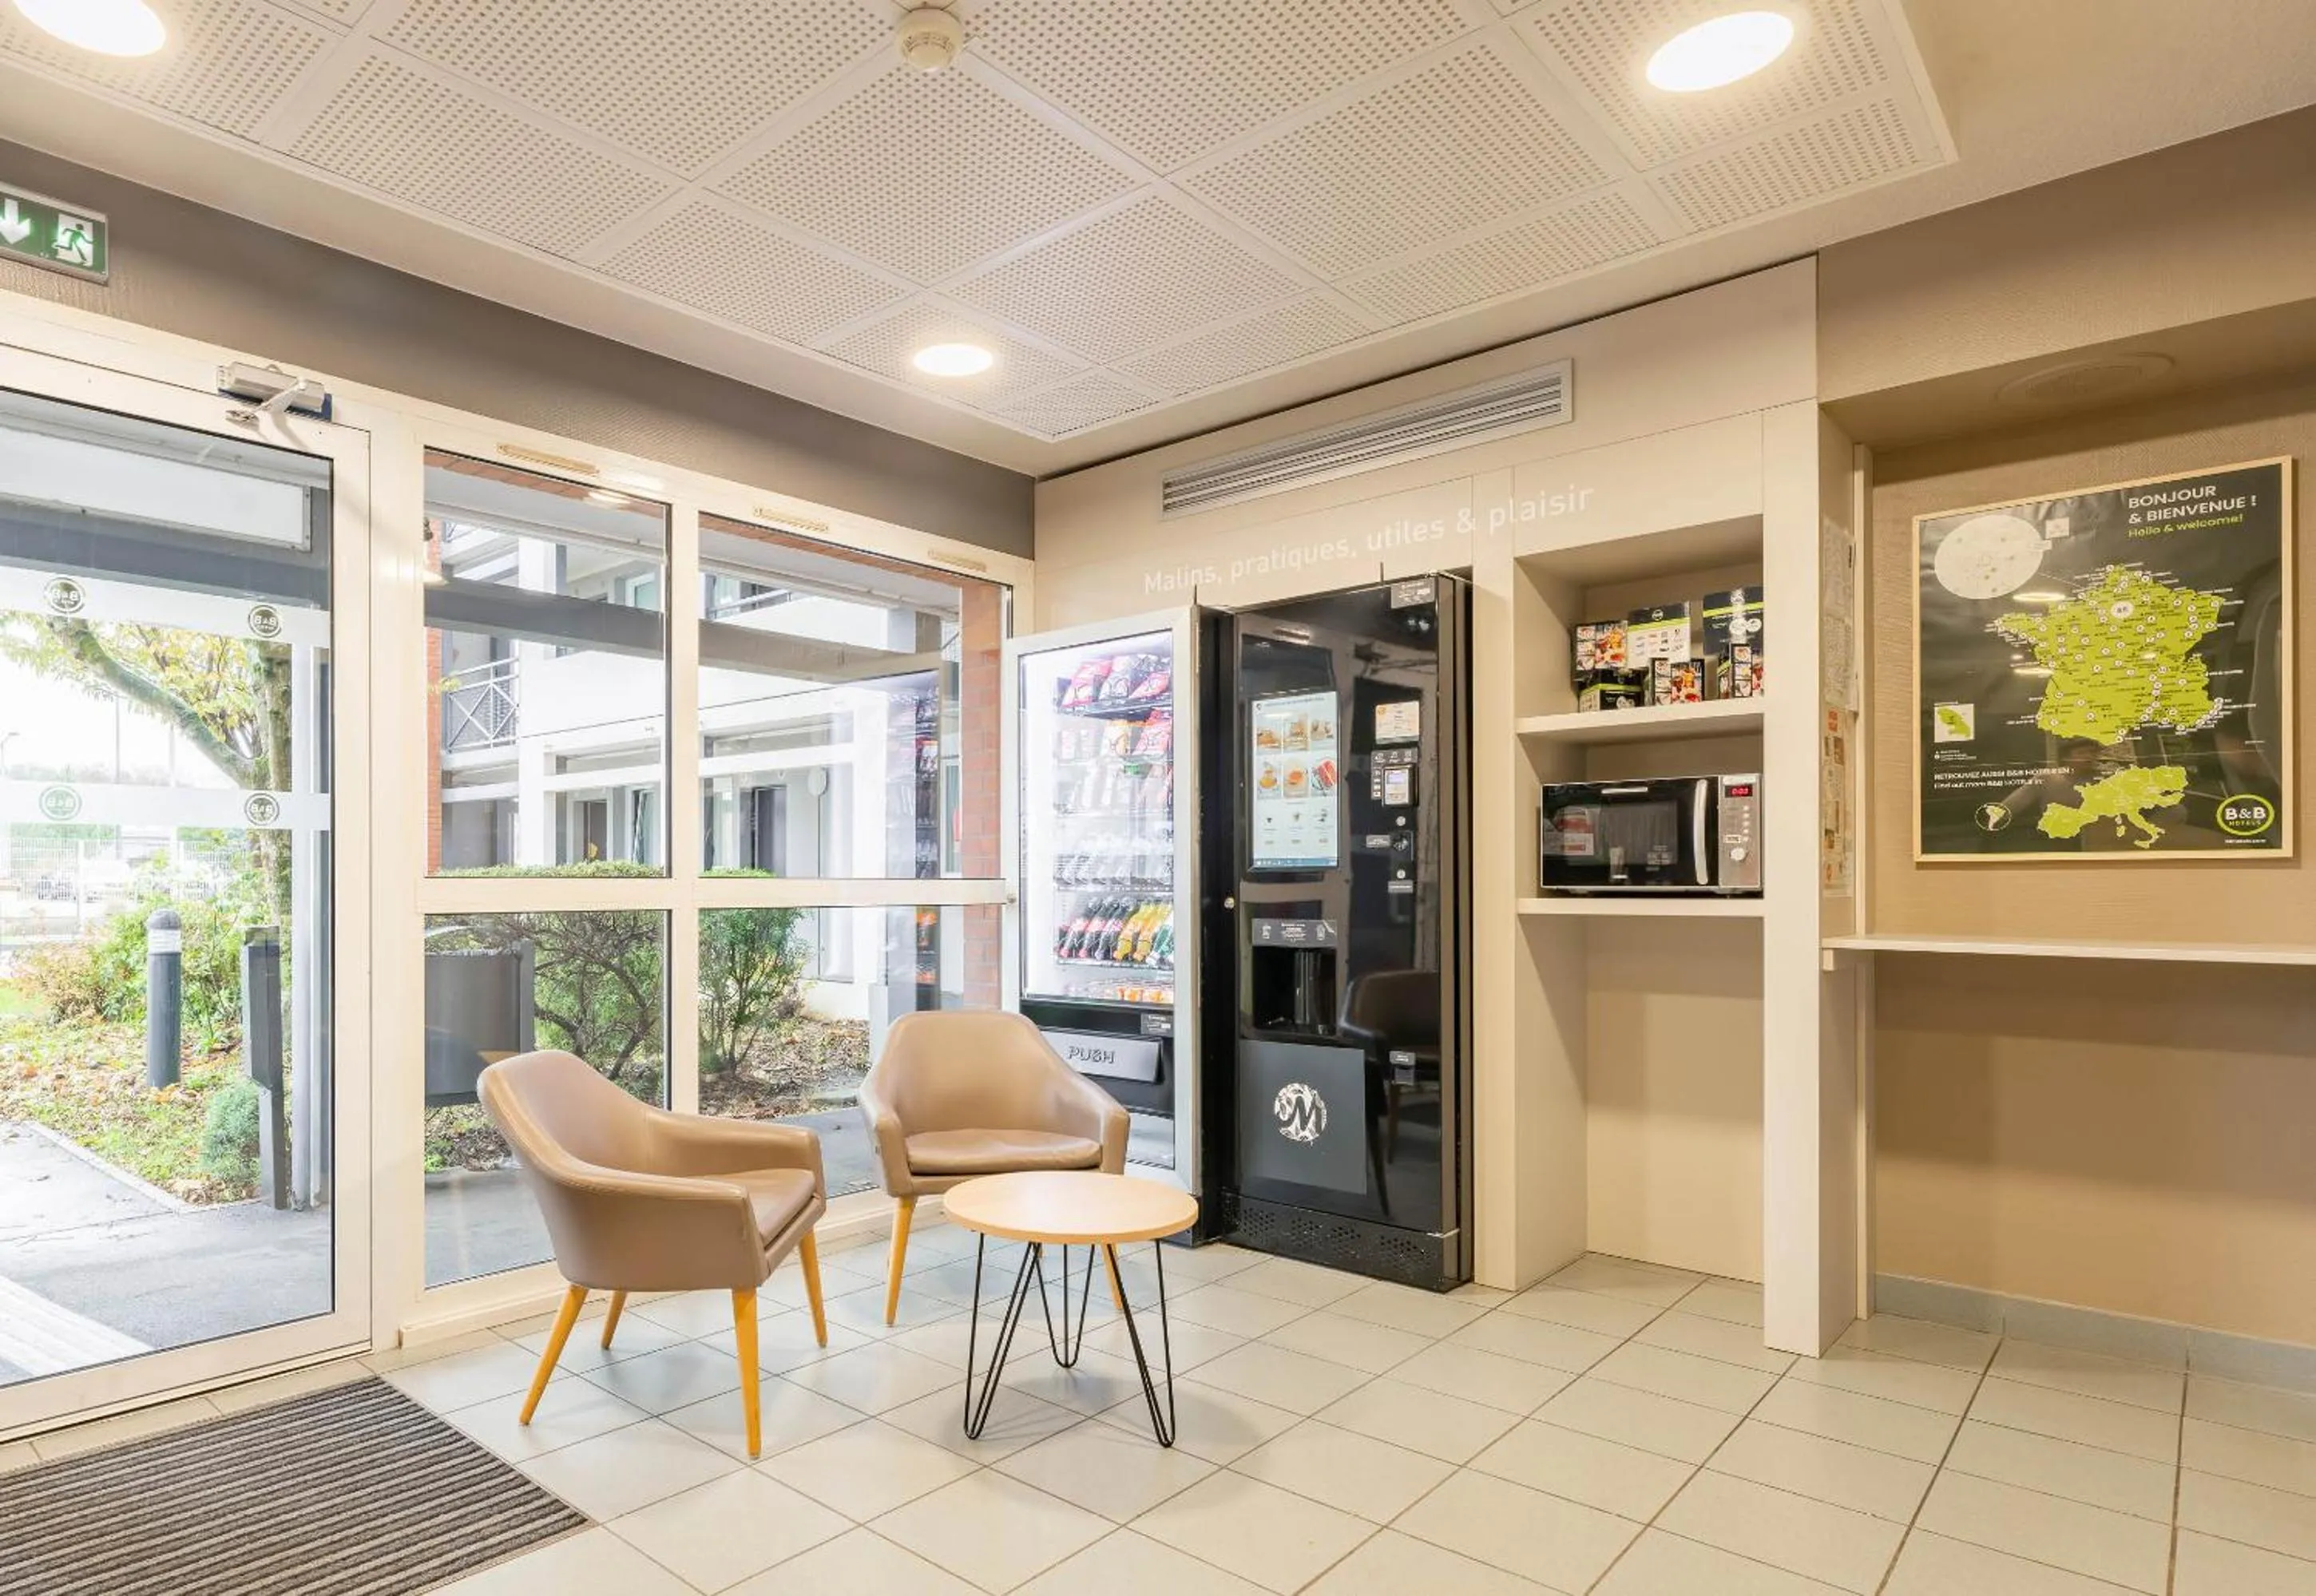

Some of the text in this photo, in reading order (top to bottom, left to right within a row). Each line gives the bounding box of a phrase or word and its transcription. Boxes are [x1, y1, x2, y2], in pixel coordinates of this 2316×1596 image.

[2128, 485, 2217, 509] BONJOUR
[2128, 495, 2257, 524] & BIENVENUE !
[2128, 513, 2243, 538] Hello & welcome!
[1144, 484, 1595, 595] Malins, pratiques, utiles & plaisir
[2225, 807, 2266, 821] B&B
[1069, 1046, 1116, 1064] PUSH
